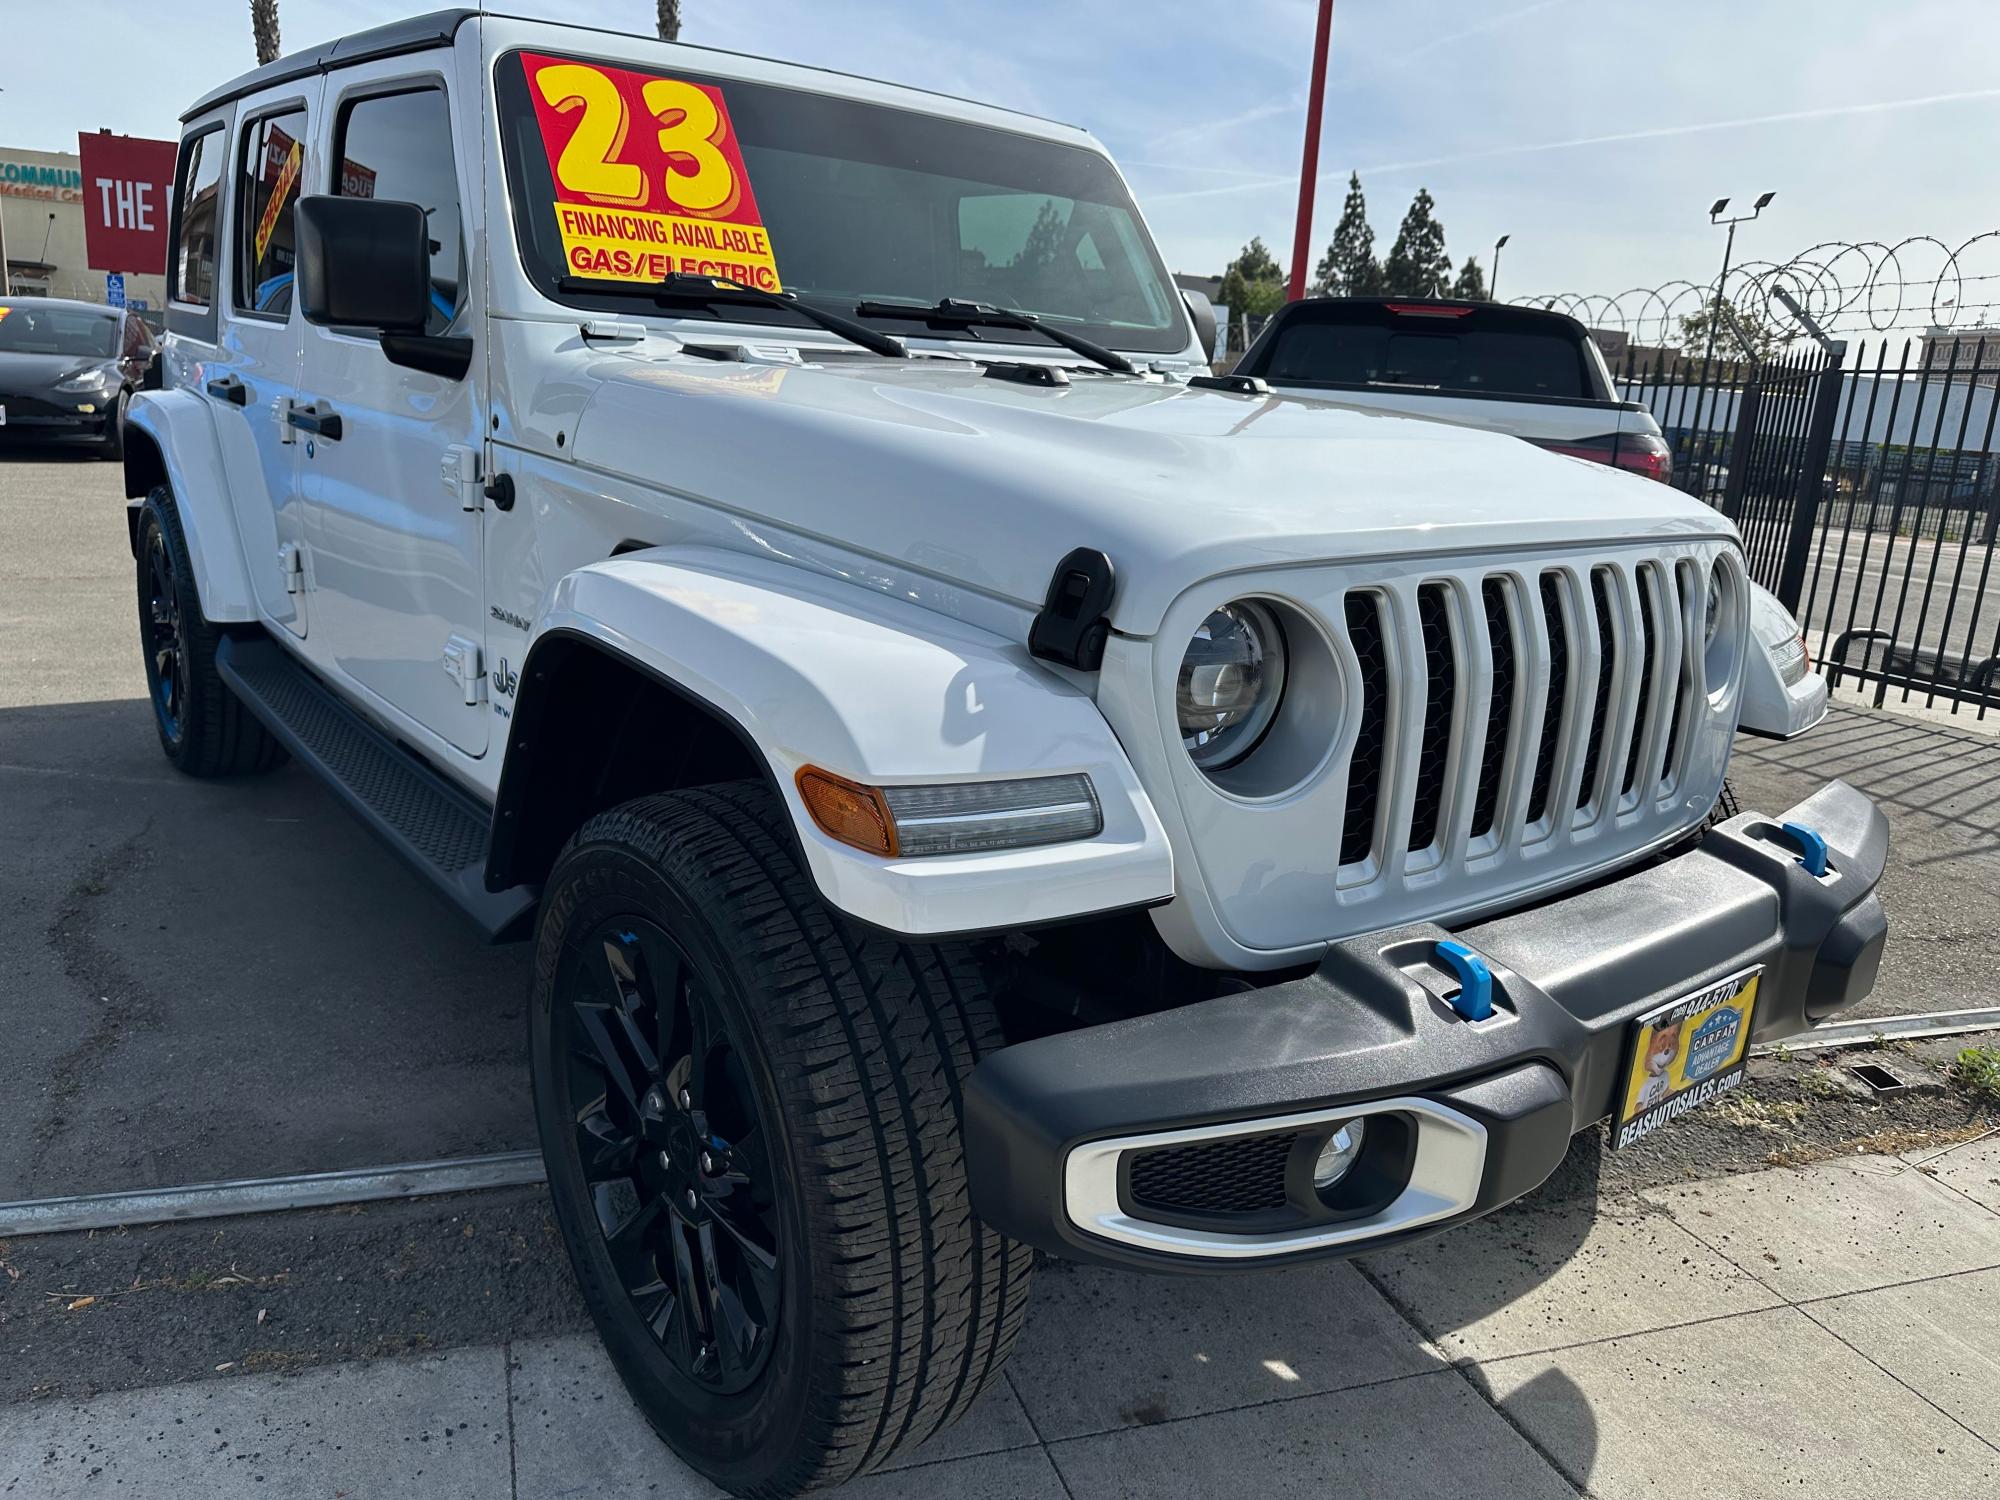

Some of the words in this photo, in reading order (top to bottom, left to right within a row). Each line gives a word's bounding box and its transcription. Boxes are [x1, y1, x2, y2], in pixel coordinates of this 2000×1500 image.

[535, 64, 739, 218] 23
[96, 178, 155, 231] THE
[561, 209, 668, 244] FINANCING
[673, 223, 768, 256] AVAILABLE
[1692, 1040, 1731, 1066] ADVANTAGE
[1694, 1056, 1720, 1076] DEALER
